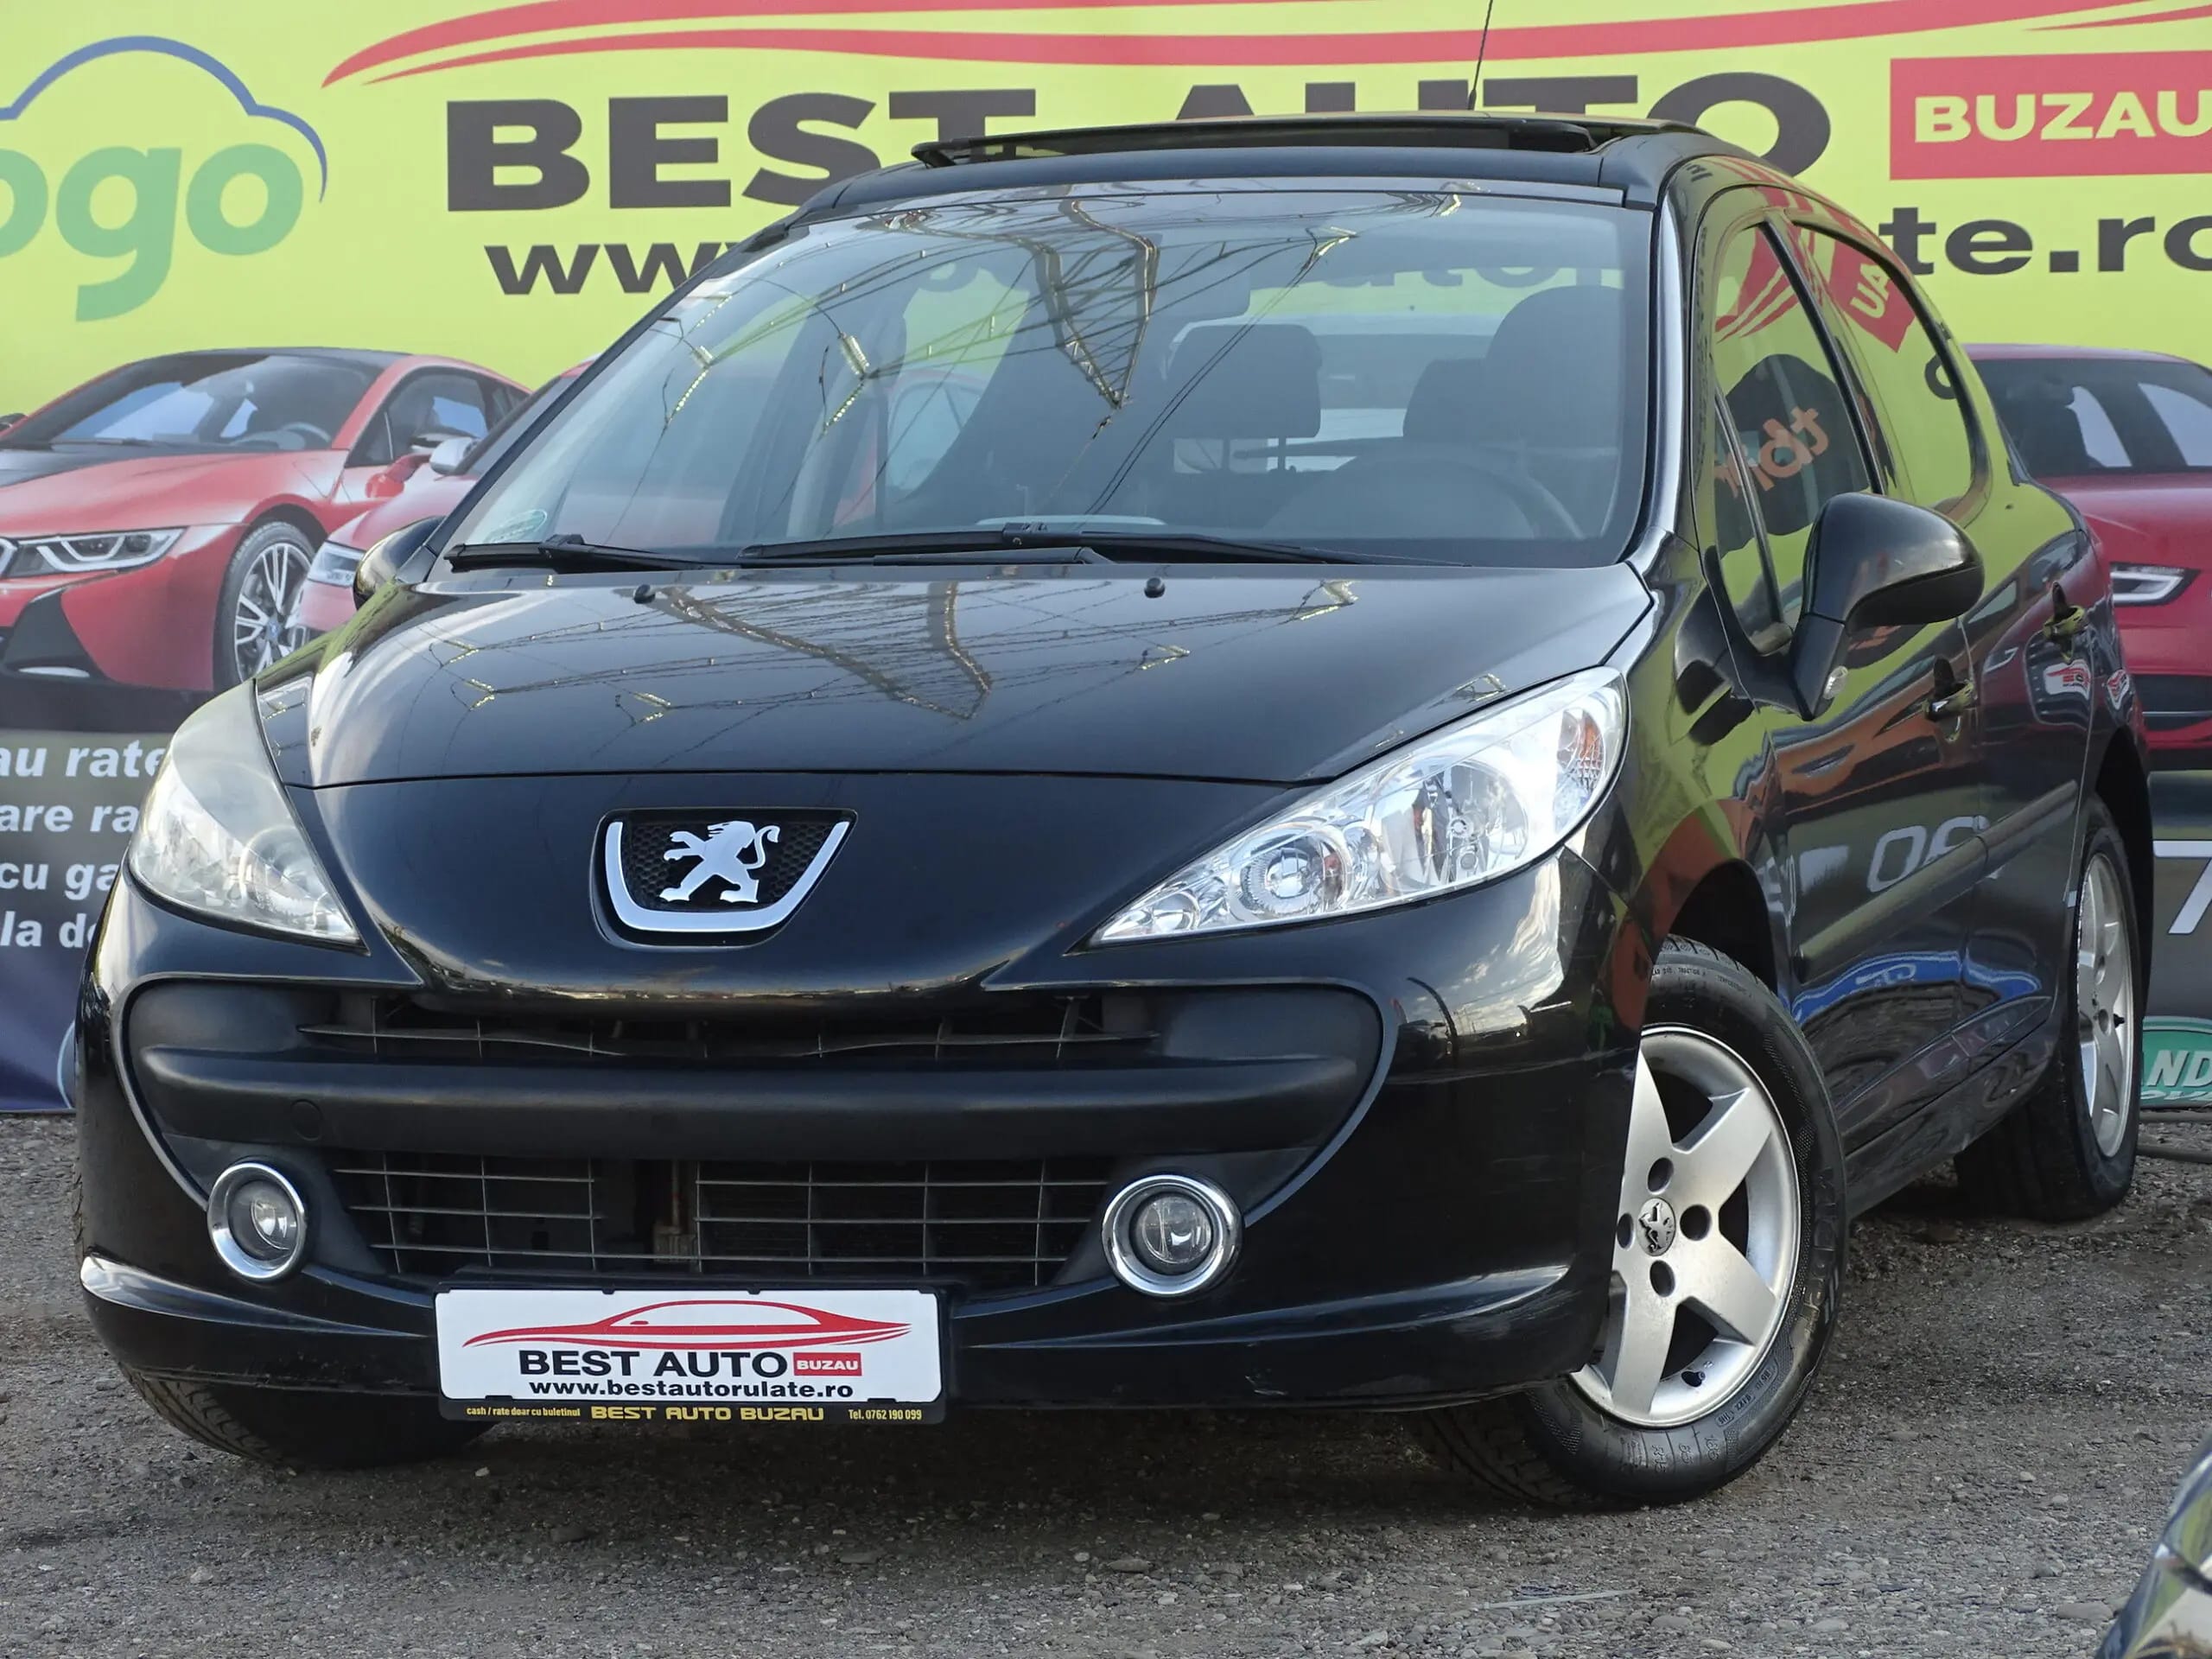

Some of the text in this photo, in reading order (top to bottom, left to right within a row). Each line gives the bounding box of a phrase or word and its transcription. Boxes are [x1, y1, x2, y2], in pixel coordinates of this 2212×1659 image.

[1915, 90, 2212, 143] BUZAU
[484, 243, 741, 296] ww
[0, 911, 97, 948] la d
[519, 1350, 859, 1378] BEST AUTO BUZAU
[529, 1380, 854, 1398] www.bestautorulate.ro
[467, 1407, 486, 1415] cash
[493, 1407, 510, 1415] rate
[511, 1406, 530, 1416] doar
[531, 1408, 541, 1416] cu
[591, 1406, 656, 1420] BEST
[665, 1407, 731, 1421] AUTO
[741, 1407, 823, 1421] BUZAU
[849, 1409, 864, 1420] Tel.
[865, 1409, 887, 1420] 0762
[889, 1409, 904, 1420] 190
[906, 1410, 922, 1420] 099
